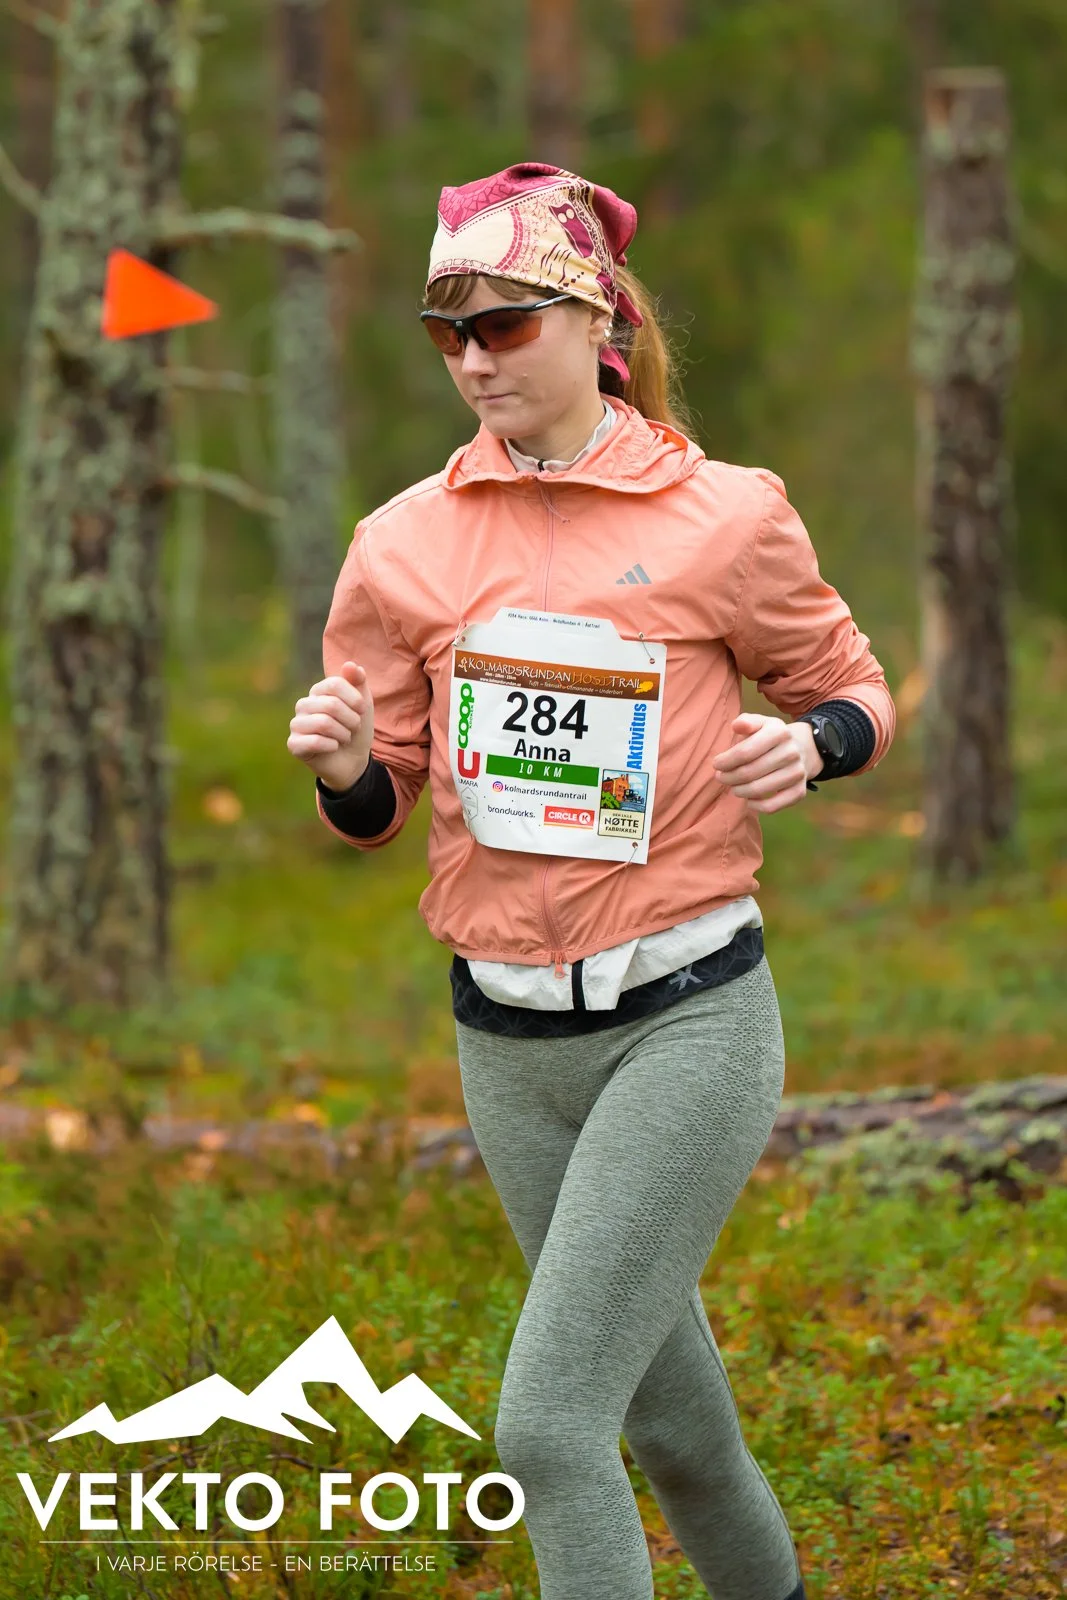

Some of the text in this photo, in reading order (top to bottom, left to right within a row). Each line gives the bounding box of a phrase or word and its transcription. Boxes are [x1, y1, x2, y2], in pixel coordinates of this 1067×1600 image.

[458, 683, 475, 749] coop
[502, 691, 588, 739] 284
[626, 703, 647, 770] Aktivitus
[513, 738, 571, 762] Anna
[519, 762, 562, 778] 10 KM
[504, 784, 587, 800] kolmardsrundantrail
[548, 811, 590, 824] CIRCLE K
[604, 817, 639, 828] NØTTE
